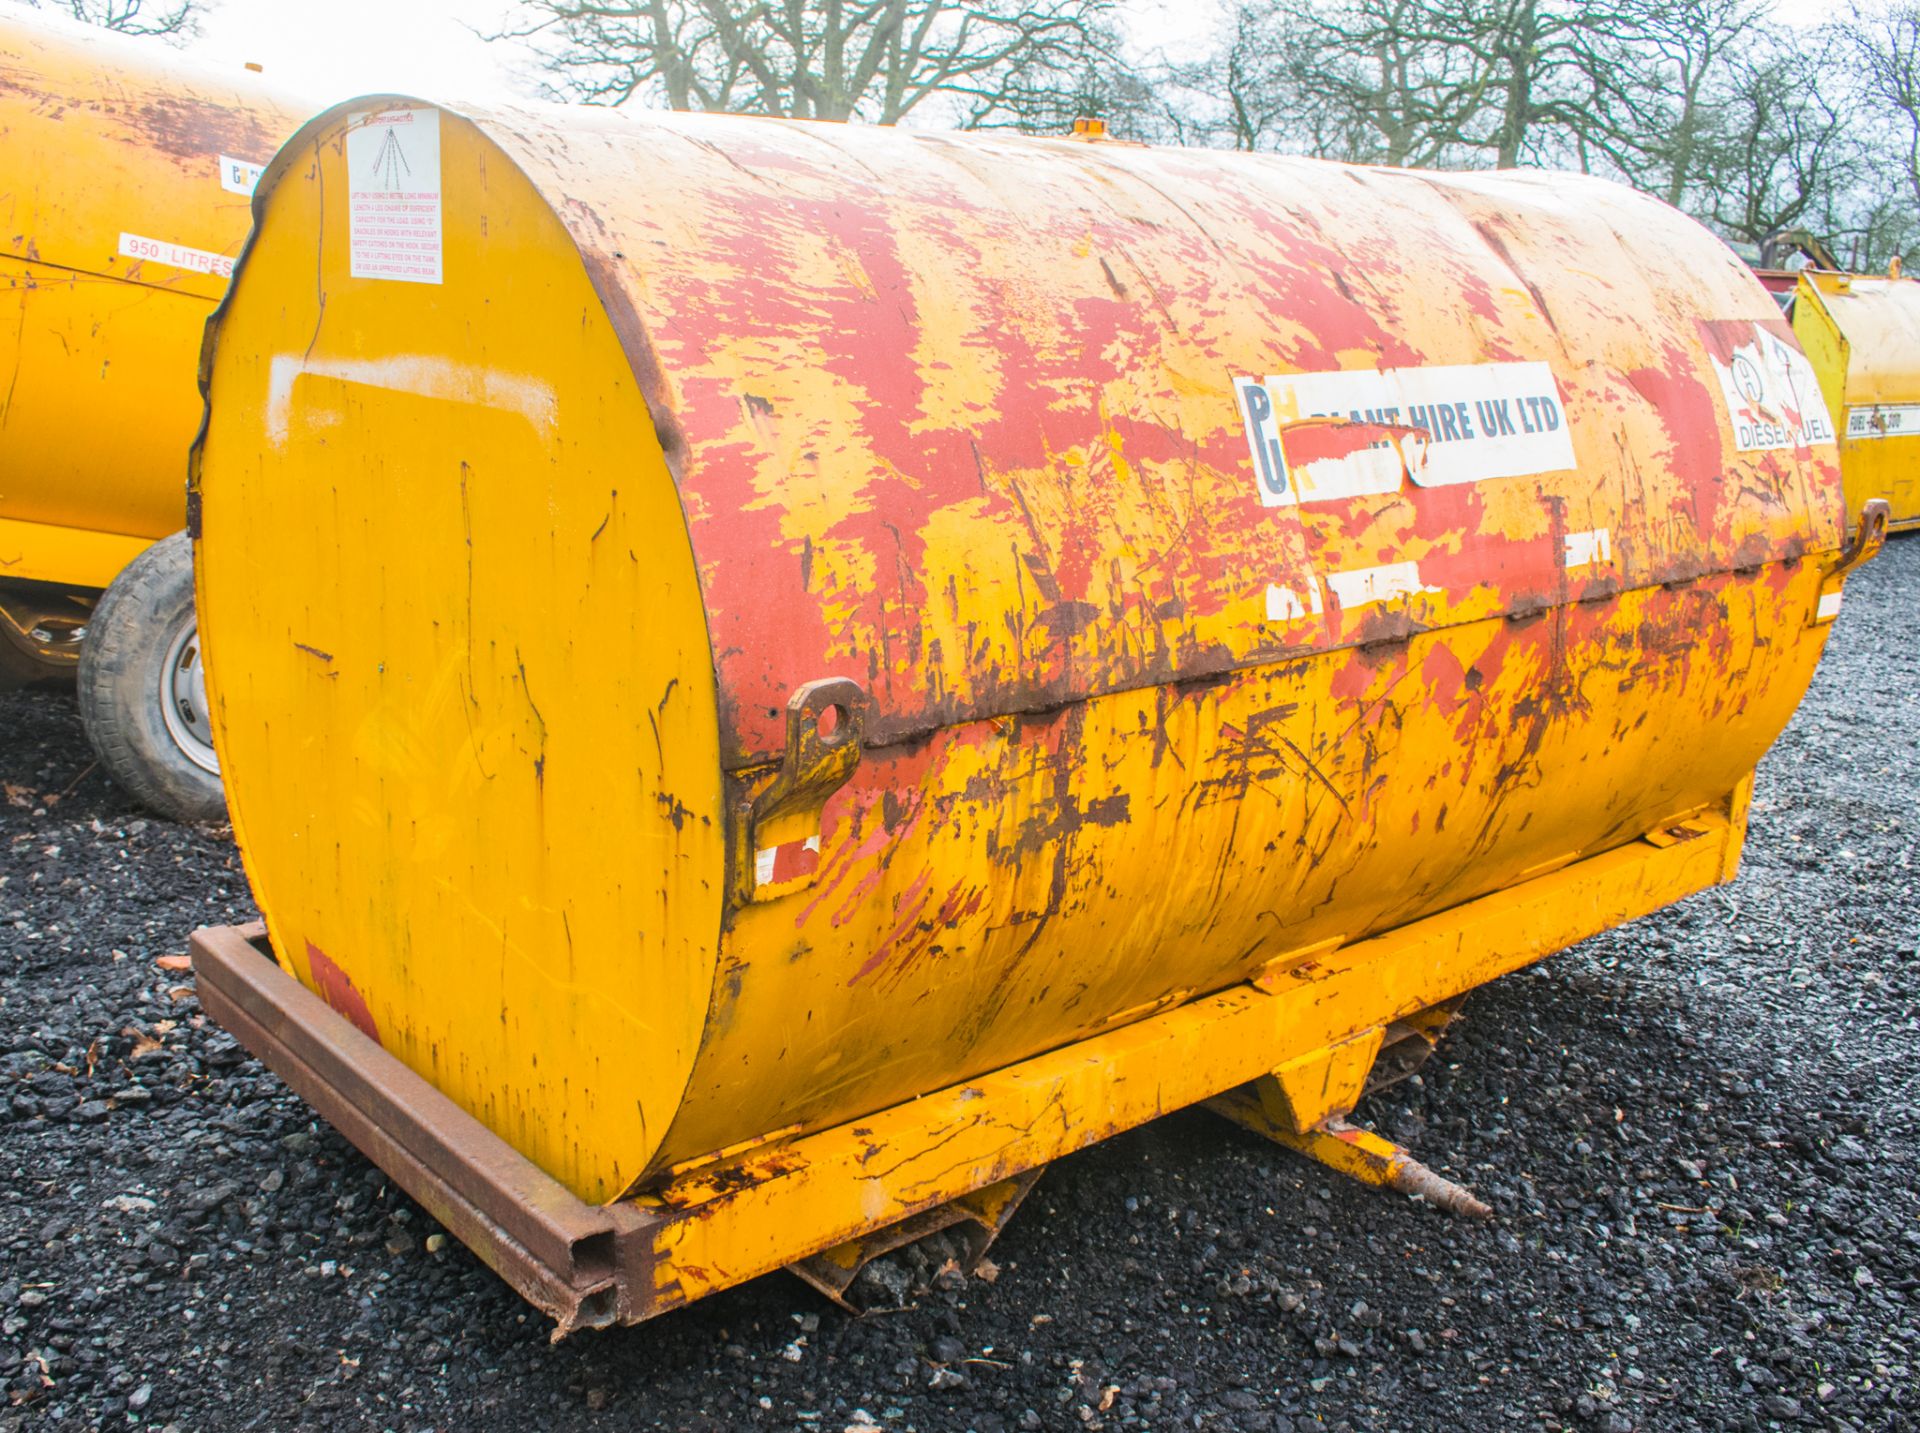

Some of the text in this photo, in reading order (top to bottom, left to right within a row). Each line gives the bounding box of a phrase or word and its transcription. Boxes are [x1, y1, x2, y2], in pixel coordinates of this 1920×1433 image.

[129, 239, 233, 277] 950 LITRES
[1408, 401, 1475, 445] HIRE
[1475, 399, 1516, 438] UK
[1515, 396, 1559, 434] LTD
[1797, 419, 1832, 443] UEL
